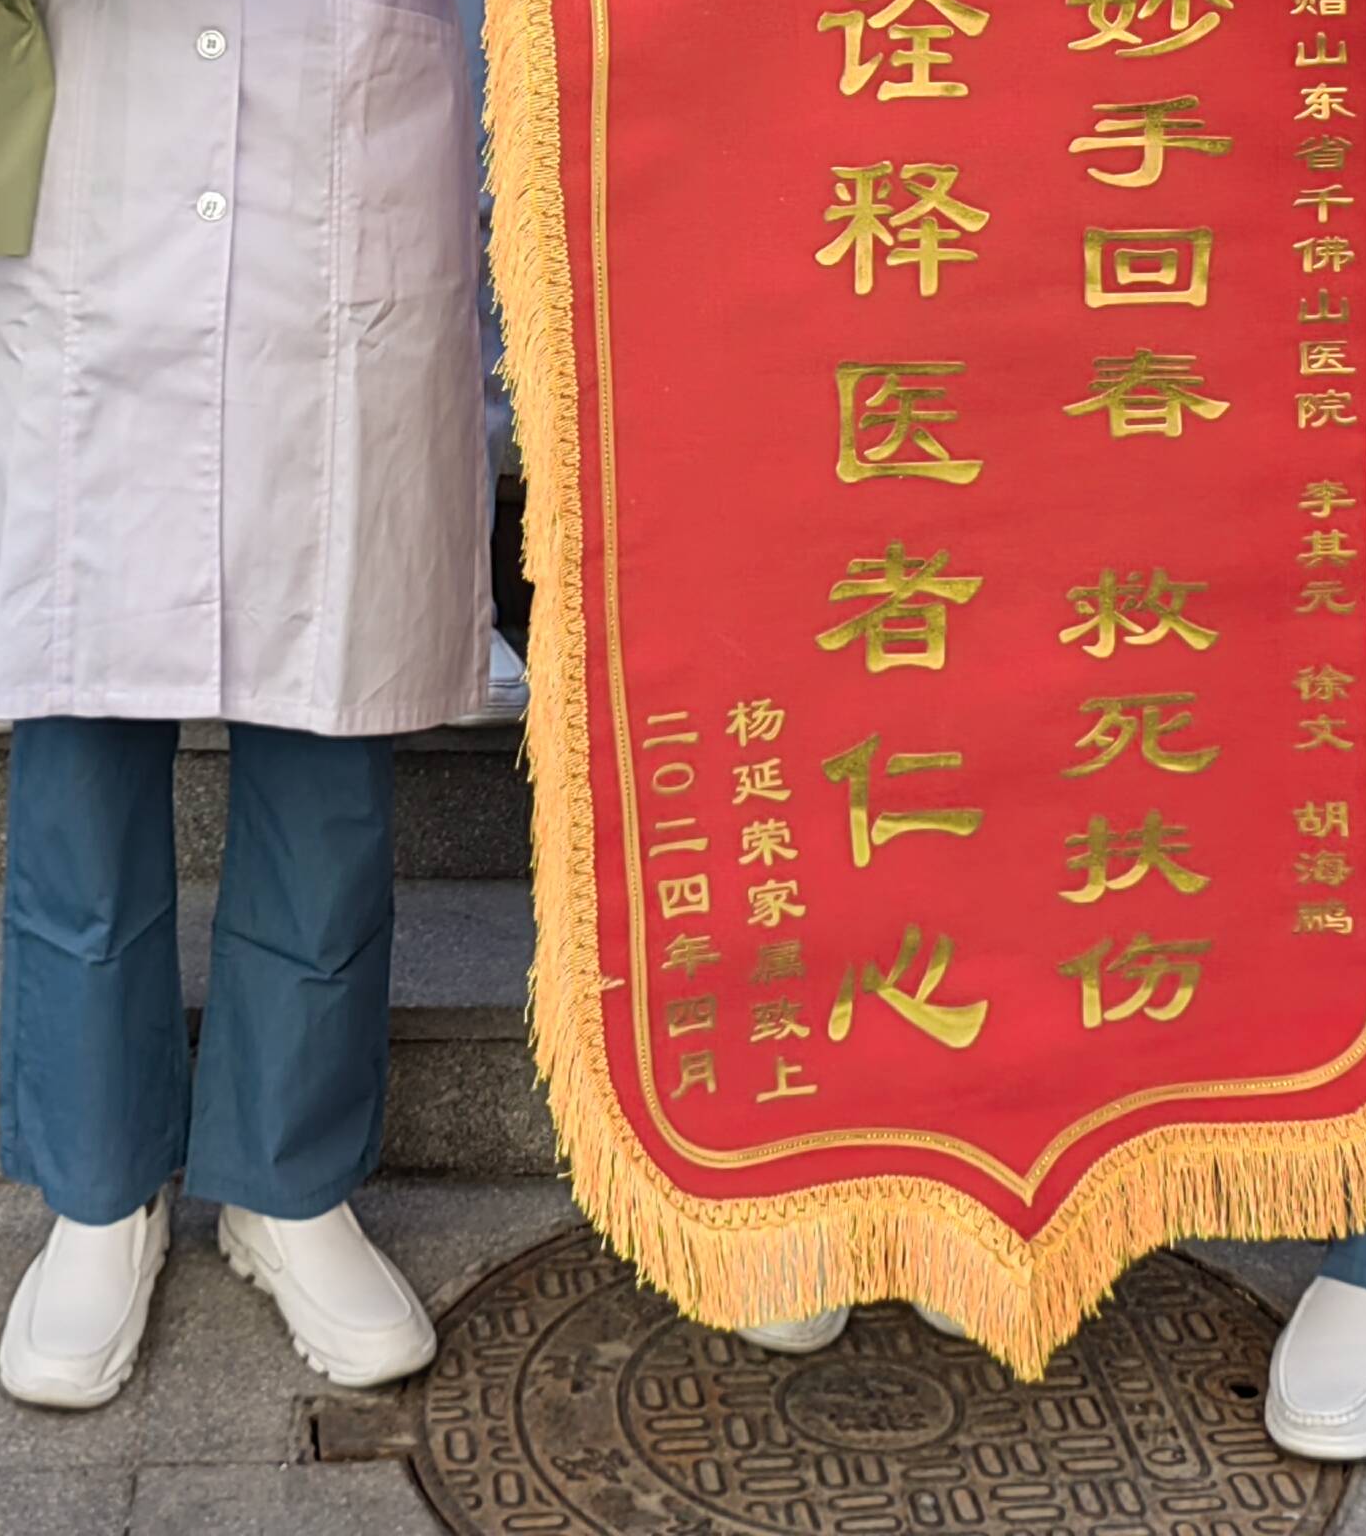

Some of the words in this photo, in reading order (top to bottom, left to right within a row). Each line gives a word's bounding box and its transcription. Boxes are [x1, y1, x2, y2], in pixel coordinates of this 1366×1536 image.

[1297, 479, 1358, 616] 李其元
[1291, 663, 1355, 753] 徐文
[1057, 566, 1220, 1030] 救死扶伤
[725, 697, 819, 1104] 杨延荣家属致上
[1292, 800, 1355, 935] 胡海鹏
